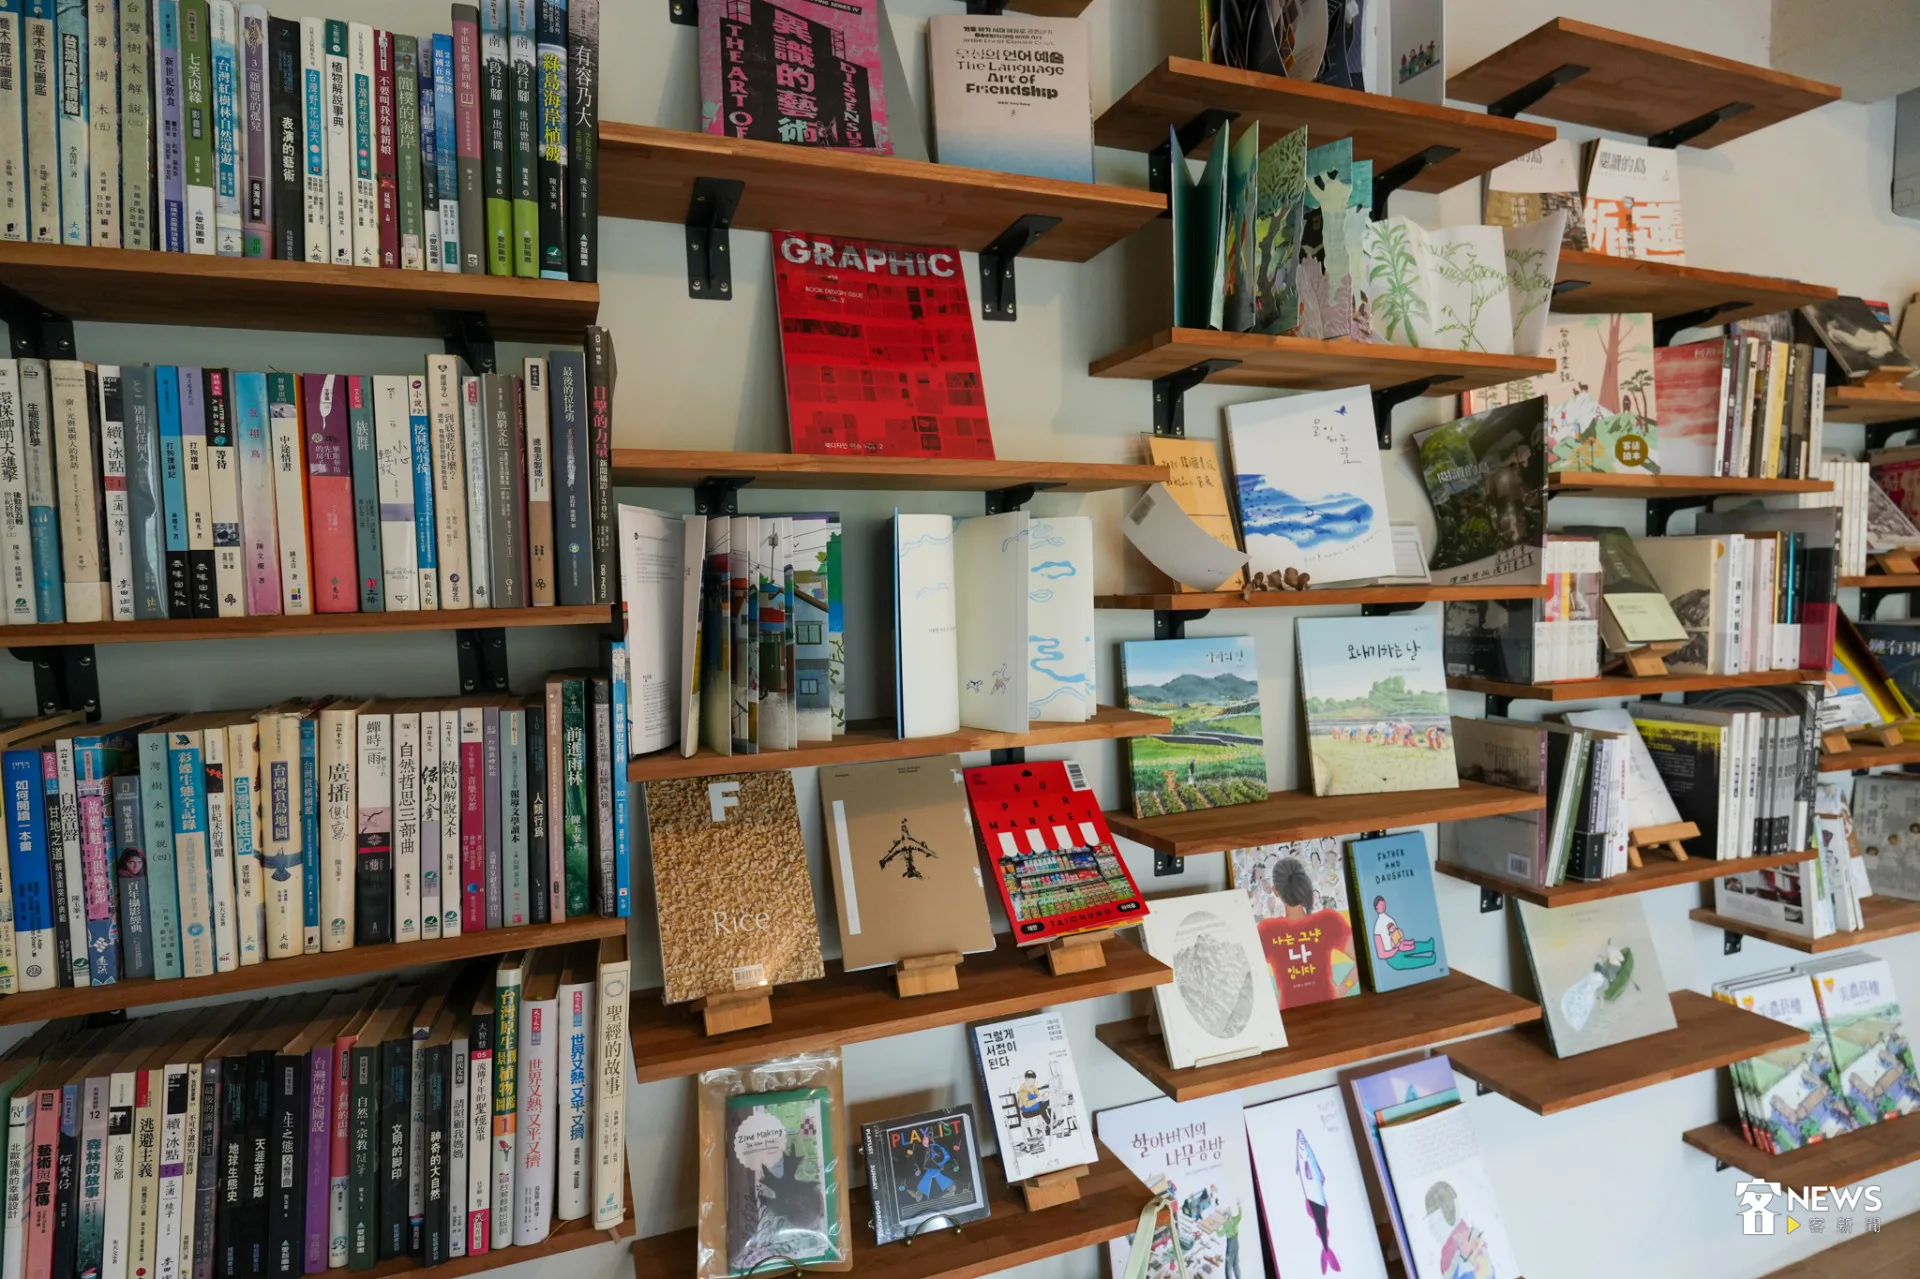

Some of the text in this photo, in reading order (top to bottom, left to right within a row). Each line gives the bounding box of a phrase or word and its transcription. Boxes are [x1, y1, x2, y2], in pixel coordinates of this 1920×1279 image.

[32, 24, 47, 97] 灌木賞花圖鑑
[251, 59, 257, 67] 3
[726, 24, 744, 63] THE
[957, 61, 1065, 76] The Language
[1002, 49, 1032, 62] 언어
[1034, 51, 1065, 64] 예술
[331, 61, 344, 127] 植物解說事典
[575, 45, 593, 128] 有容乃大
[728, 66, 749, 107] ART
[772, 8, 818, 142] 異識的藝術
[965, 83, 1059, 99] Friendship
[987, 72, 1036, 84] Art of
[218, 59, 233, 166] 台灣紅樹林自然導遊
[249, 72, 261, 131] 亞細亞的孤兒
[379, 76, 392, 155] 不要叫我外籍新娘
[398, 76, 416, 149] 簡樸的海岸
[542, 53, 562, 163] 綠島海岸植被
[839, 62, 862, 147] DISSENSUS
[281, 117, 295, 182] 表演的藝術
[780, 237, 955, 278] GRAPHIC
[412, 390, 422, 408] 小說
[561, 366, 575, 423] 最後的拉比勇
[28, 403, 42, 446] 生態設計學
[355, 420, 369, 451] 族群
[592, 385, 607, 457] 目擊的力量
[215, 450, 226, 470] 等待
[278, 435, 291, 472] 中途情書
[413, 423, 428, 474] 挖洞的小孩
[113, 495, 124, 512] 三浦
[1410, 643, 1422, 661] 날
[565, 726, 583, 786] 前進雨林
[15, 780, 33, 852] 如何閱讀一本書
[61, 792, 79, 842] 自然音聲
[176, 751, 197, 831] 彩蝶生態全記錄
[235, 778, 253, 854] 台灣賞蛙記
[272, 764, 290, 839] 台灣賞鳥地圖
[327, 762, 351, 843] 廣播側寫
[397, 741, 418, 856] 自然哲思三部曲
[442, 759, 459, 839] 綠島解說文本
[509, 788, 521, 844] 報導文學讀本
[708, 781, 740, 822] F
[48, 805, 64, 861] 甘地之道
[87, 801, 107, 903] 故鄉魅力俱樂部
[211, 803, 224, 858] 世紀末的華麗
[1376, 848, 1406, 862] FATHER
[1374, 869, 1416, 885] DAUGHTER
[1384, 859, 1401, 870] AND
[127, 880, 143, 933] 百年攝影經典
[713, 910, 772, 936] Rice
[1050, 909, 1113, 928] TAICHUNG
[1272, 929, 1322, 946] 나는 그냥
[1288, 944, 1313, 963] 나
[1287, 964, 1318, 980] 입니다
[478, 1021, 487, 1050] 大智慧
[602, 1004, 624, 1096] 聖經的故事
[983, 1027, 1015, 1044] 그렇게
[986, 1042, 1018, 1057] 서점이
[988, 1055, 1010, 1070] 된다
[89, 1110, 101, 1120] 12
[310, 1056, 327, 1133] 台灣歷史圖說
[474, 1062, 487, 1143] 流傳千年的聖經故事
[137, 1117, 155, 1178] 逃避主義
[453, 1098, 465, 1160] 請照顧我媽媽
[500, 1118, 508, 1134] 1
[756, 1128, 784, 1140] Making
[891, 1120, 961, 1149] PLAYLIST
[1131, 1121, 1207, 1158] 할아버지의
[34, 1143, 53, 1207] 藝術與宣傳
[83, 1137, 102, 1198] 森林的故事
[113, 1144, 125, 1180] 炎夏之都
[226, 1142, 240, 1202] 地球生態史
[252, 1138, 266, 1199] 天涯若比鄰
[429, 1131, 442, 1201] 神奇的大自然
[865, 1128, 878, 1191] PLAYLIST SUNDAY
[1165, 1137, 1225, 1168] 나무공방
[7, 1143, 21, 1219] 北歐瑞典的幸福設計
[164, 1179, 176, 1196] 三浦
